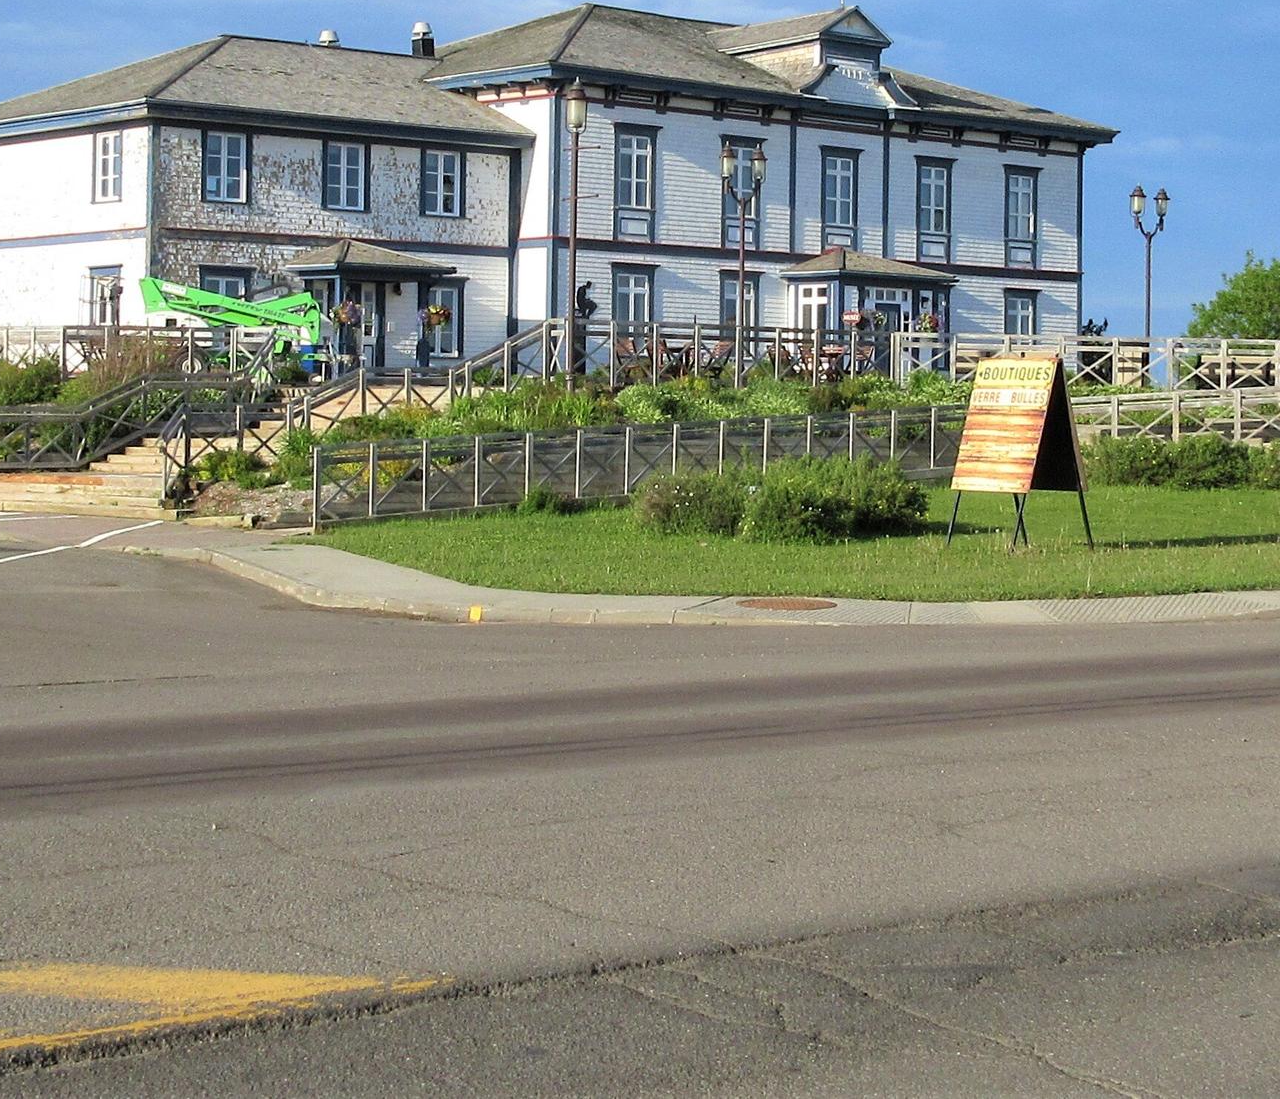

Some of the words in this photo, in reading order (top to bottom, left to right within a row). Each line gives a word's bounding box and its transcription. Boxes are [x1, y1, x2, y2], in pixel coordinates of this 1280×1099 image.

[983, 367, 1050, 381] BOUTIQUES
[972, 391, 1000, 403] VERRE
[1010, 391, 1046, 404] BULLES
